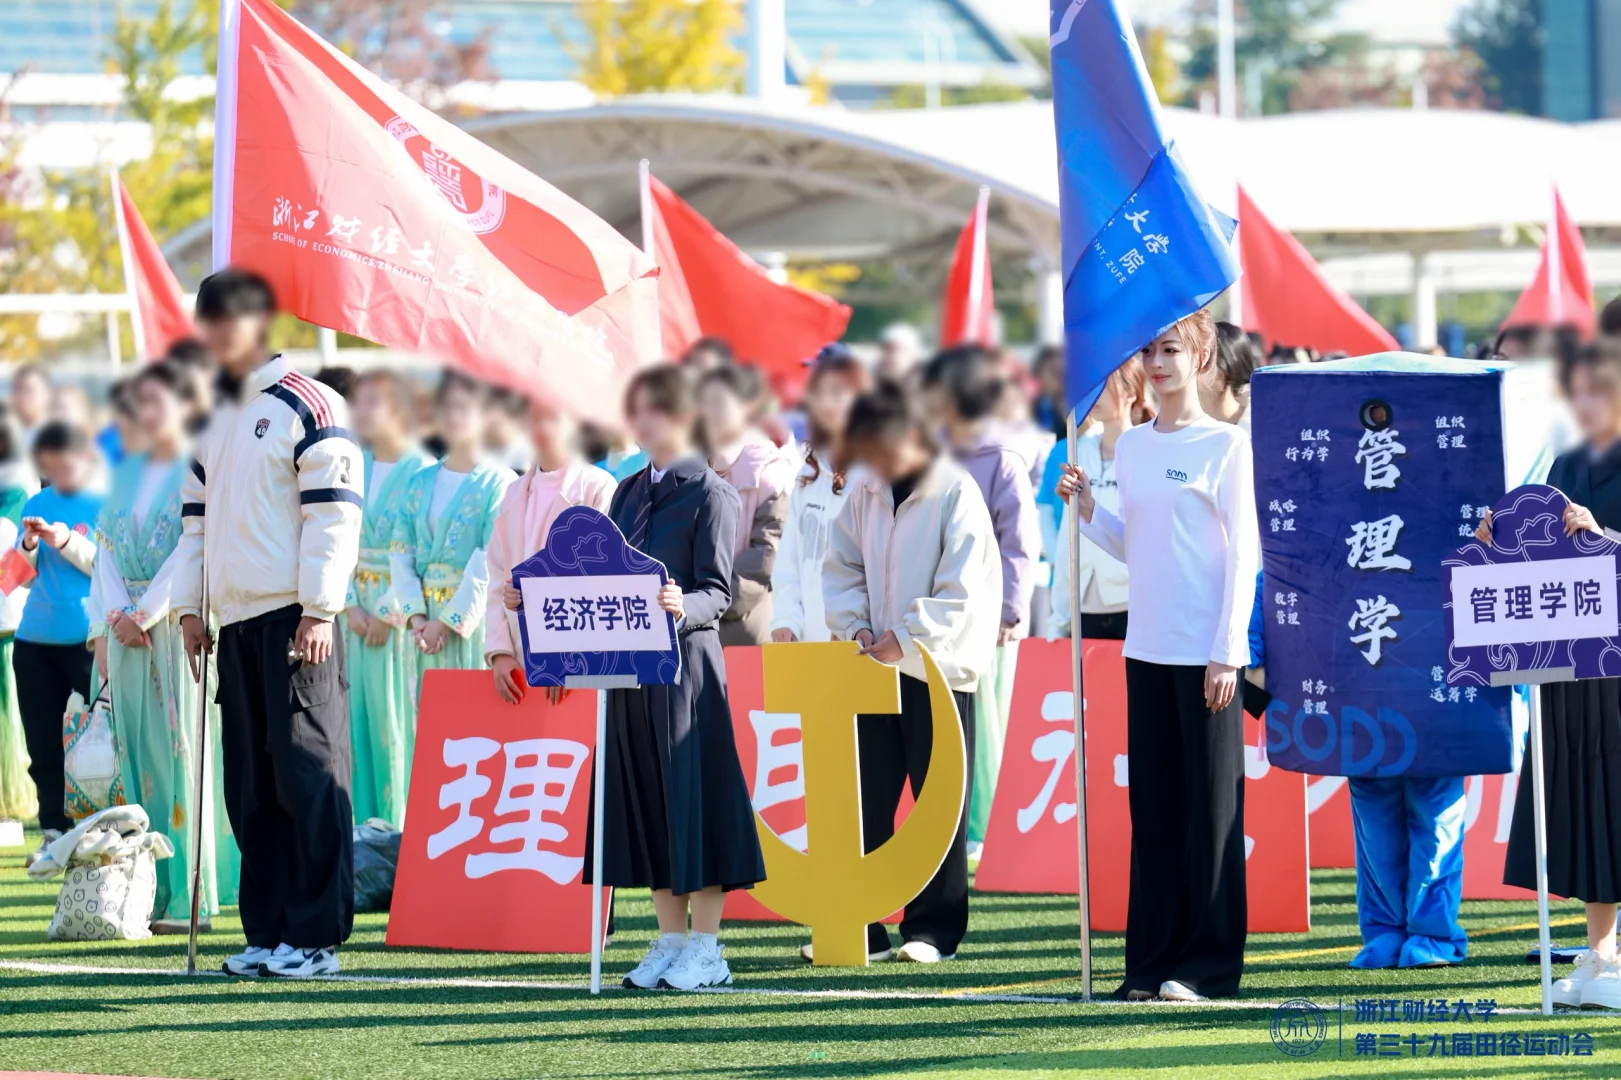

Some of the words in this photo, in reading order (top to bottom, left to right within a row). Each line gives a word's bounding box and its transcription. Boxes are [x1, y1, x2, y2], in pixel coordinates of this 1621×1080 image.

[1124, 193, 1170, 254] 大学
[297, 239, 308, 249] OF
[1106, 260, 1127, 284] ZUFE
[1435, 416, 1465, 428] 组织
[1300, 428, 1330, 441] 组织
[1437, 434, 1467, 449] 管理
[1285, 446, 1329, 461] 行为学
[1268, 499, 1298, 513] 战略
[1270, 517, 1296, 532] 管理
[1458, 523, 1476, 538] 统
[1470, 579, 1602, 624] 管理学院
[542, 594, 651, 631] 经济学院
[1276, 609, 1300, 625] 管理
[1430, 665, 1445, 682] 管
[1302, 679, 1328, 695] 财务
[1429, 685, 1478, 703] 运筹学
[1303, 699, 1329, 715] 管理
[427, 736, 590, 886] 理
